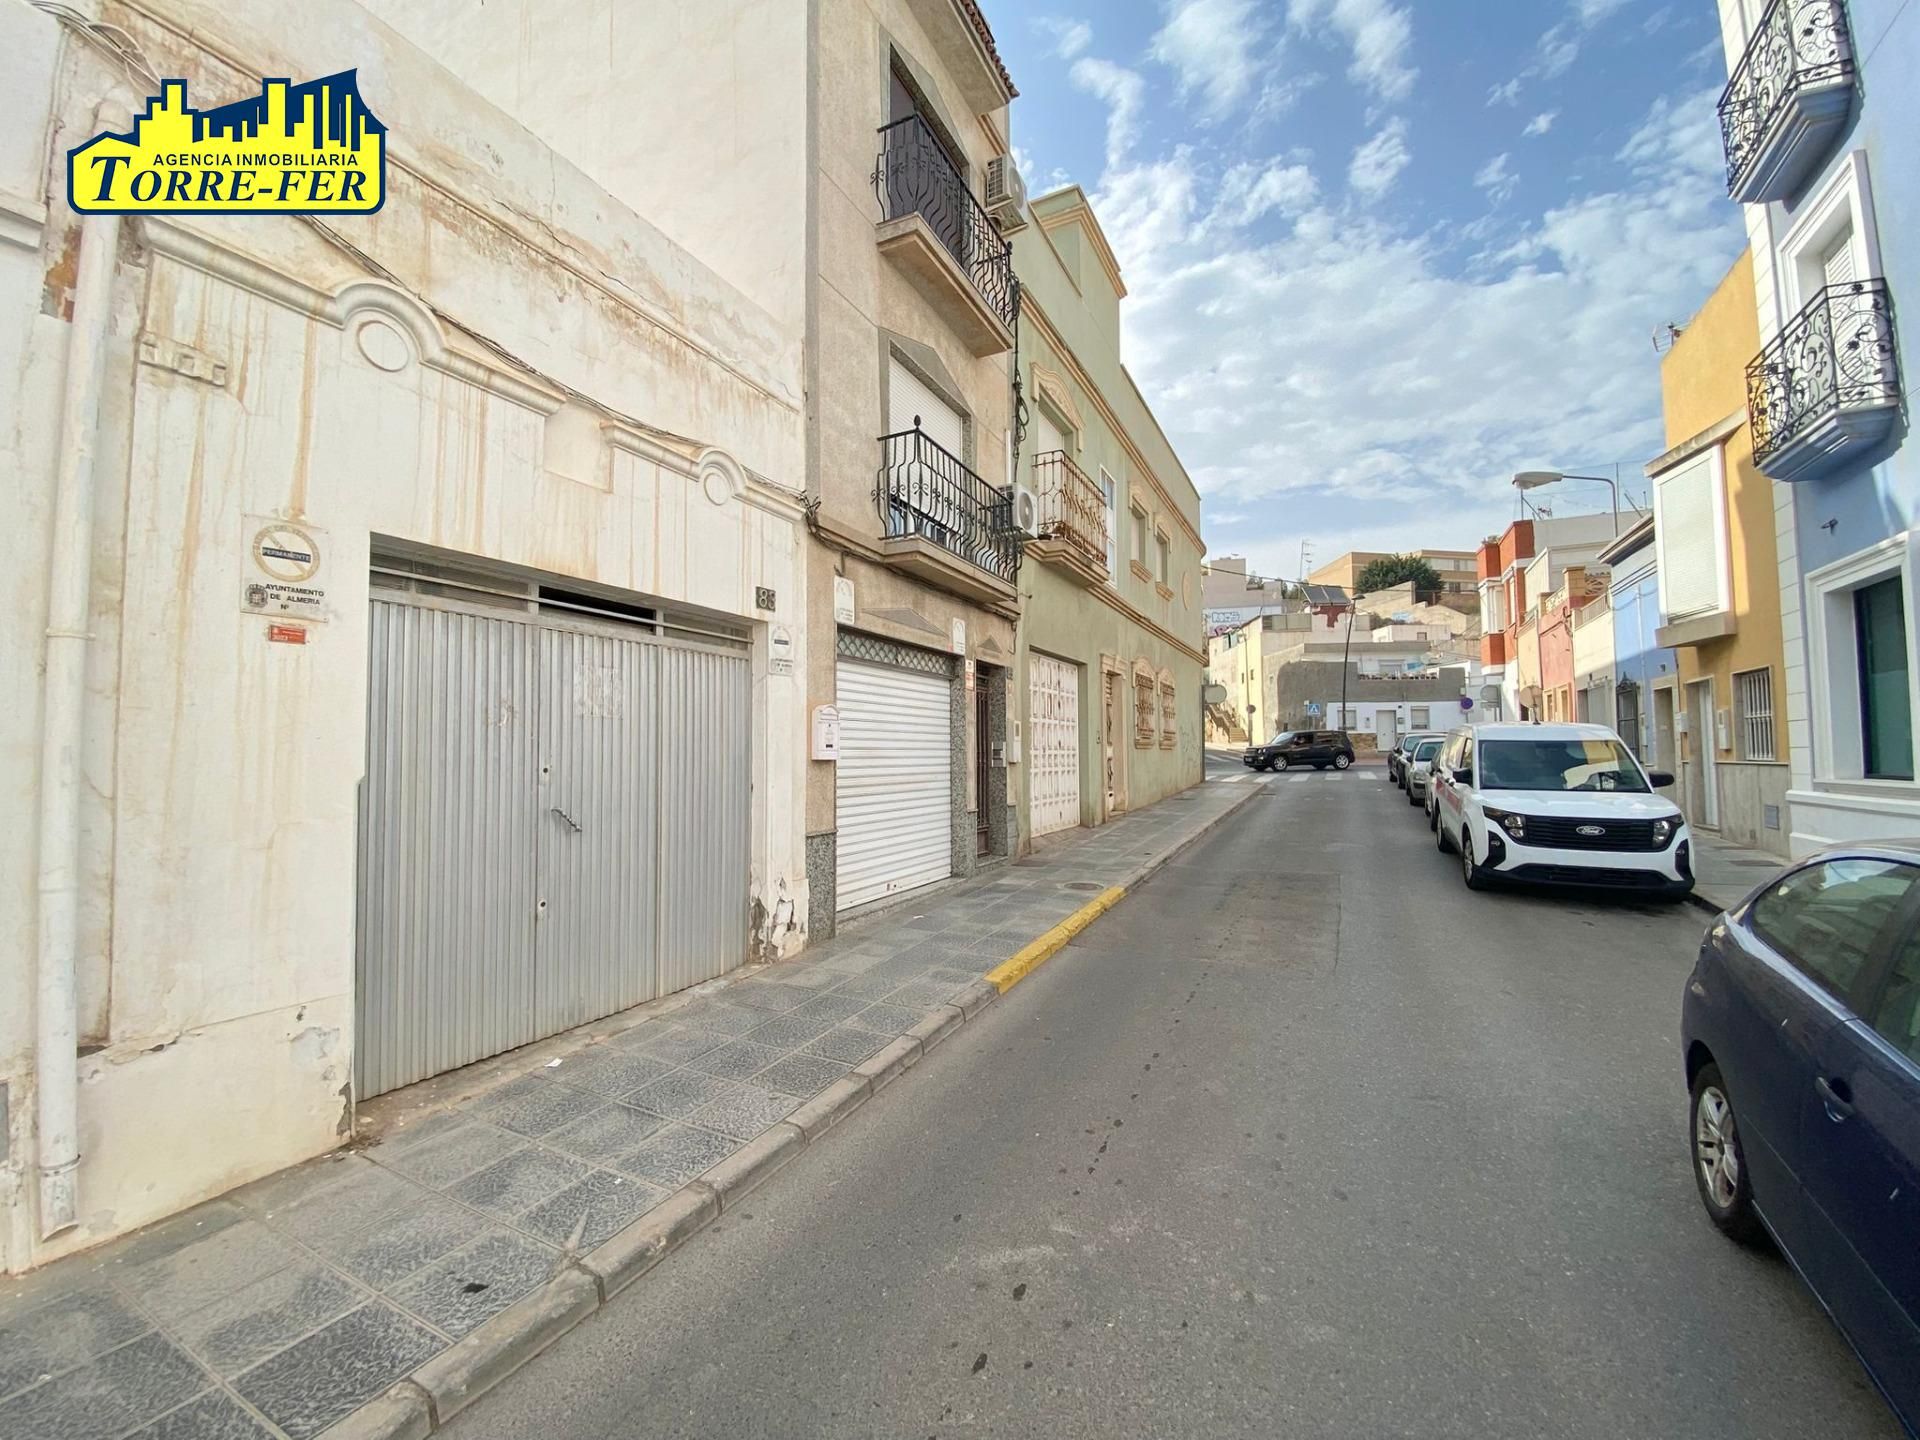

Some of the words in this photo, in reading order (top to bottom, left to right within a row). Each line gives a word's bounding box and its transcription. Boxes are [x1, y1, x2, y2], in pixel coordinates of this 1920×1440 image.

[262, 549, 310, 562] PERMANENTE
[265, 583, 325, 597] AYUNTAMIENTO
[270, 593, 281, 601] DE
[286, 595, 320, 605] ALMERIA
